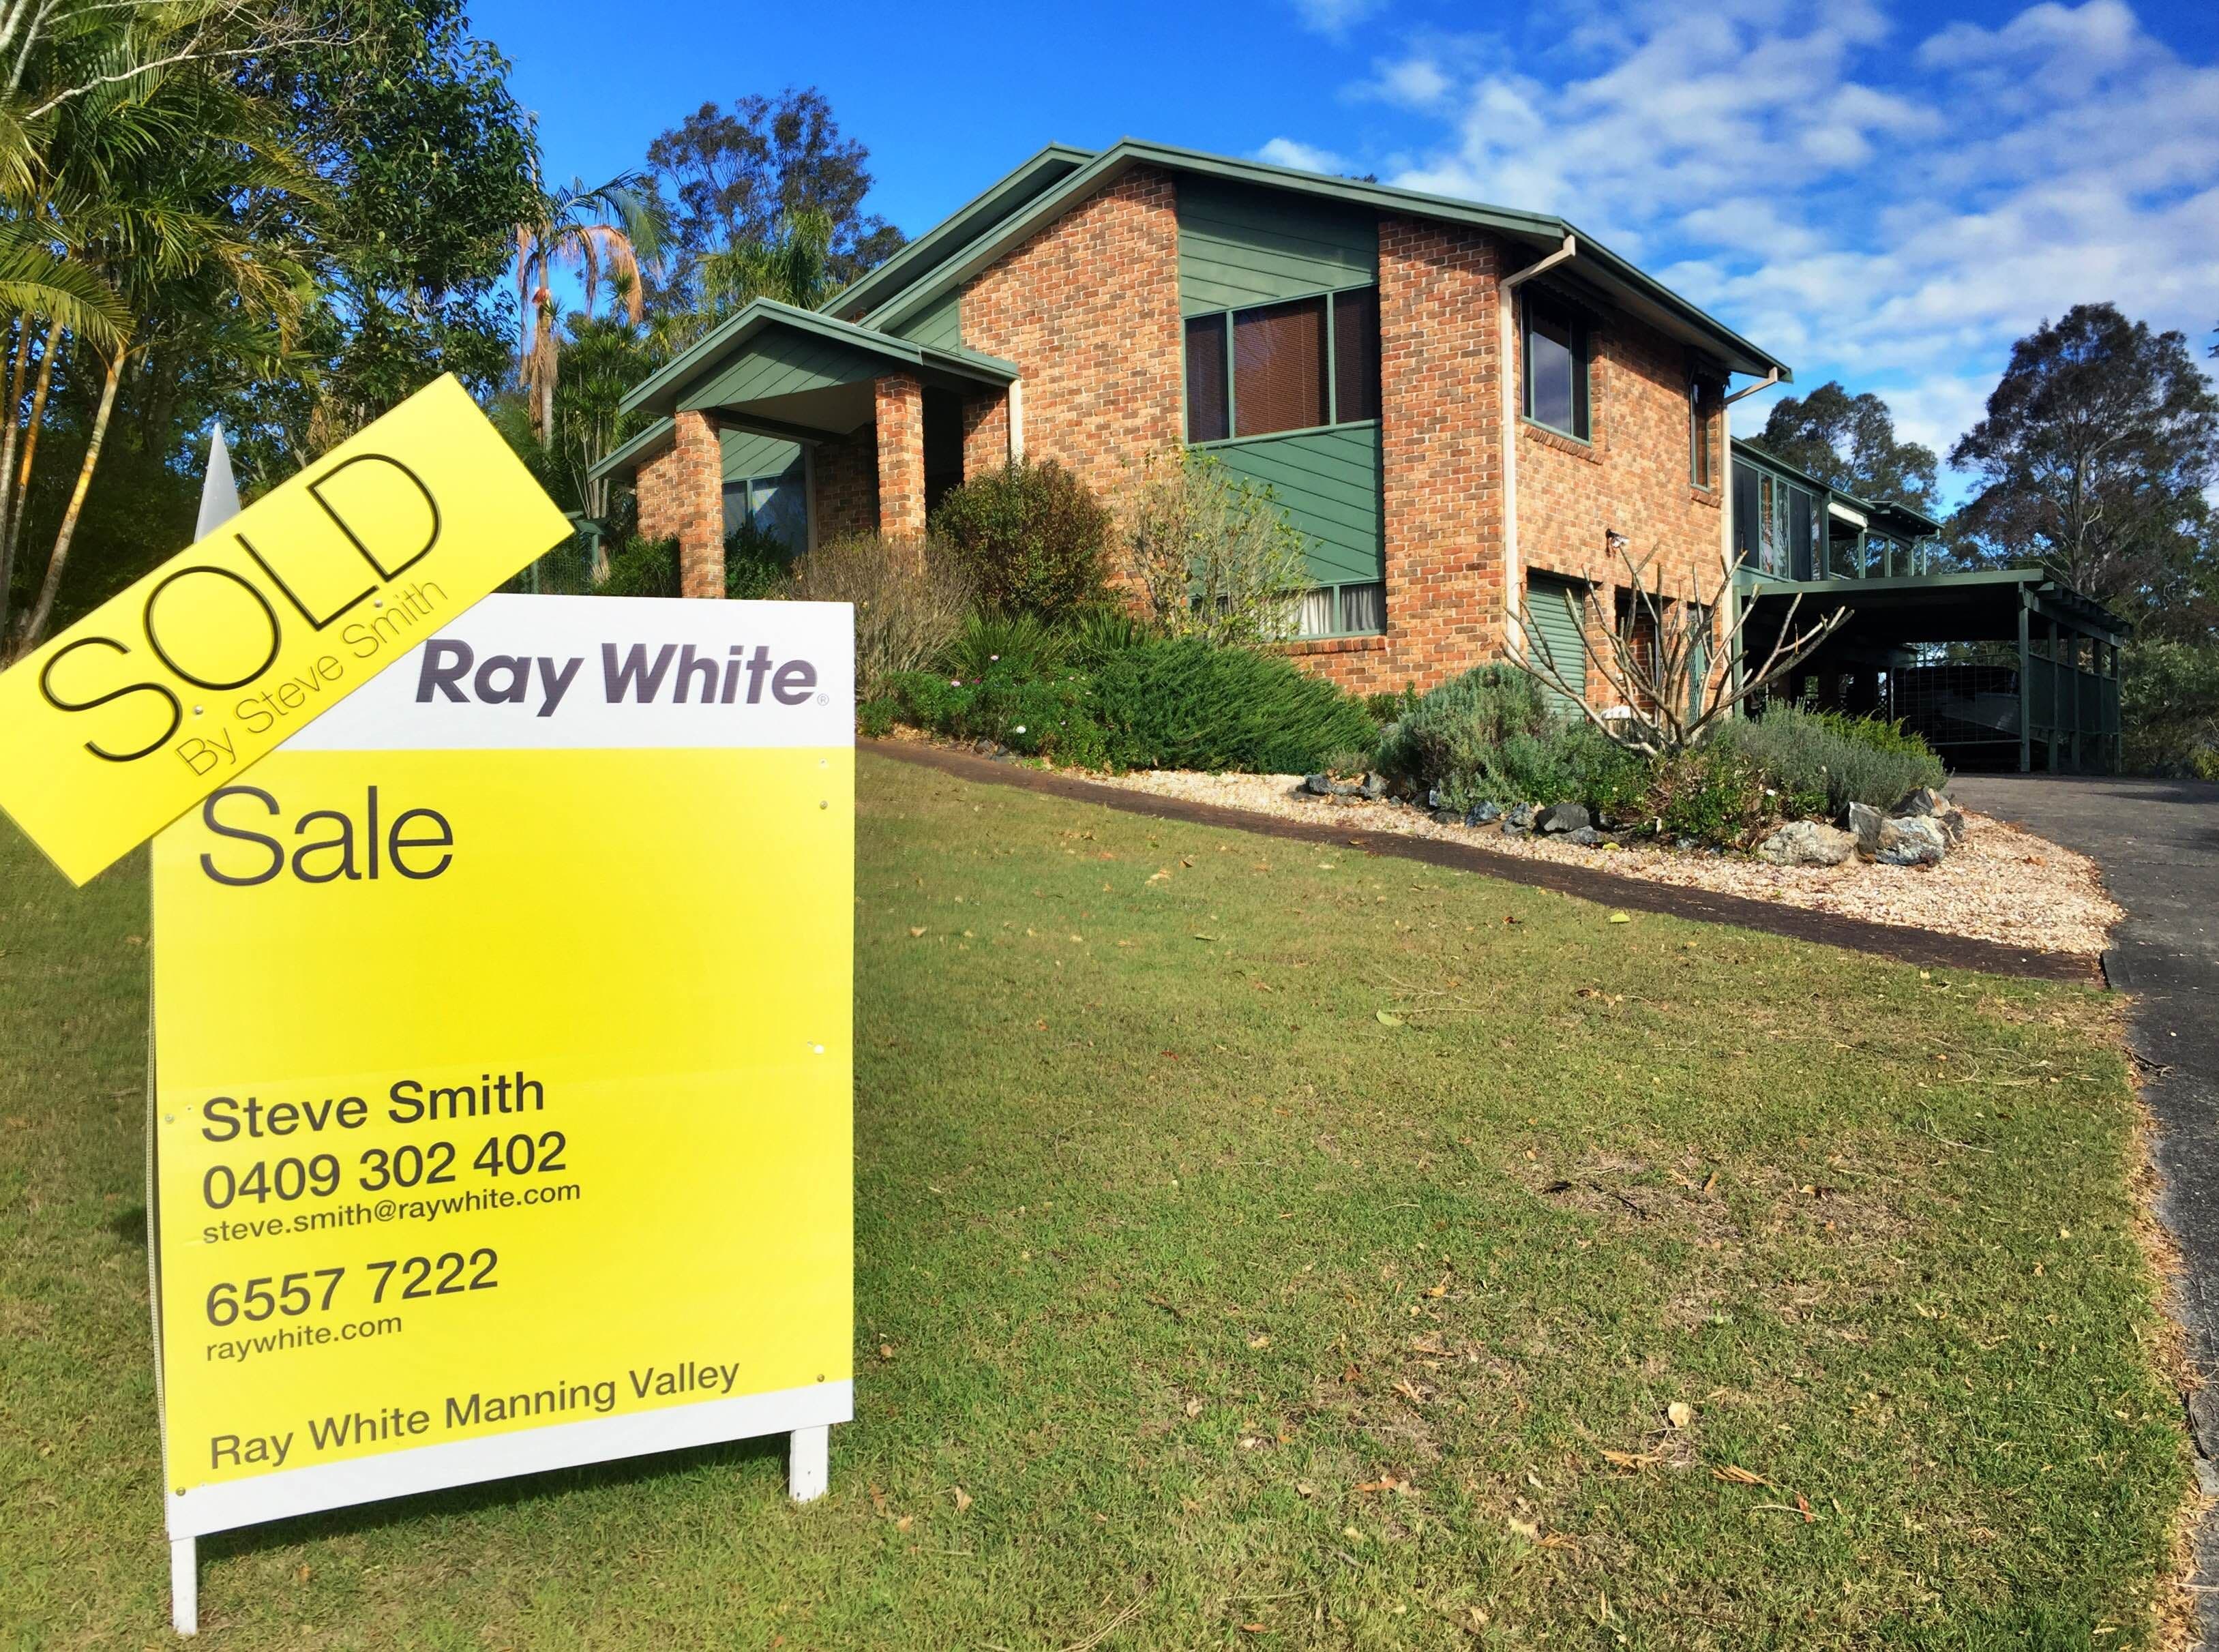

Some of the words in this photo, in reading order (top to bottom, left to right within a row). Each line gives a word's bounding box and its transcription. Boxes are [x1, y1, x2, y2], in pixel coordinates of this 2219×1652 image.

[40, 453, 441, 762] SOLD
[175, 727, 237, 777] By
[235, 654, 344, 733] Steve
[340, 580, 448, 659] Smith
[416, 640, 584, 717] Ray
[602, 644, 816, 705] White
[200, 785, 453, 886] Sale
[203, 1097, 367, 1141] Steve
[389, 1072, 543, 1123] Smith
[204, 1154, 340, 1209] 0409
[360, 1142, 456, 1190] 302
[473, 1131, 565, 1177] 402
[203, 1181, 580, 1244] steve.smith@raywhite.com
[207, 1267, 345, 1327] 6557
[367, 1248, 497, 1303] 7222
[207, 1315, 402, 1362] raywhite.com
[211, 1431, 295, 1469] Ray
[309, 1409, 429, 1450] White
[447, 1381, 614, 1428] Manning
[629, 1362, 739, 1398] Valley
